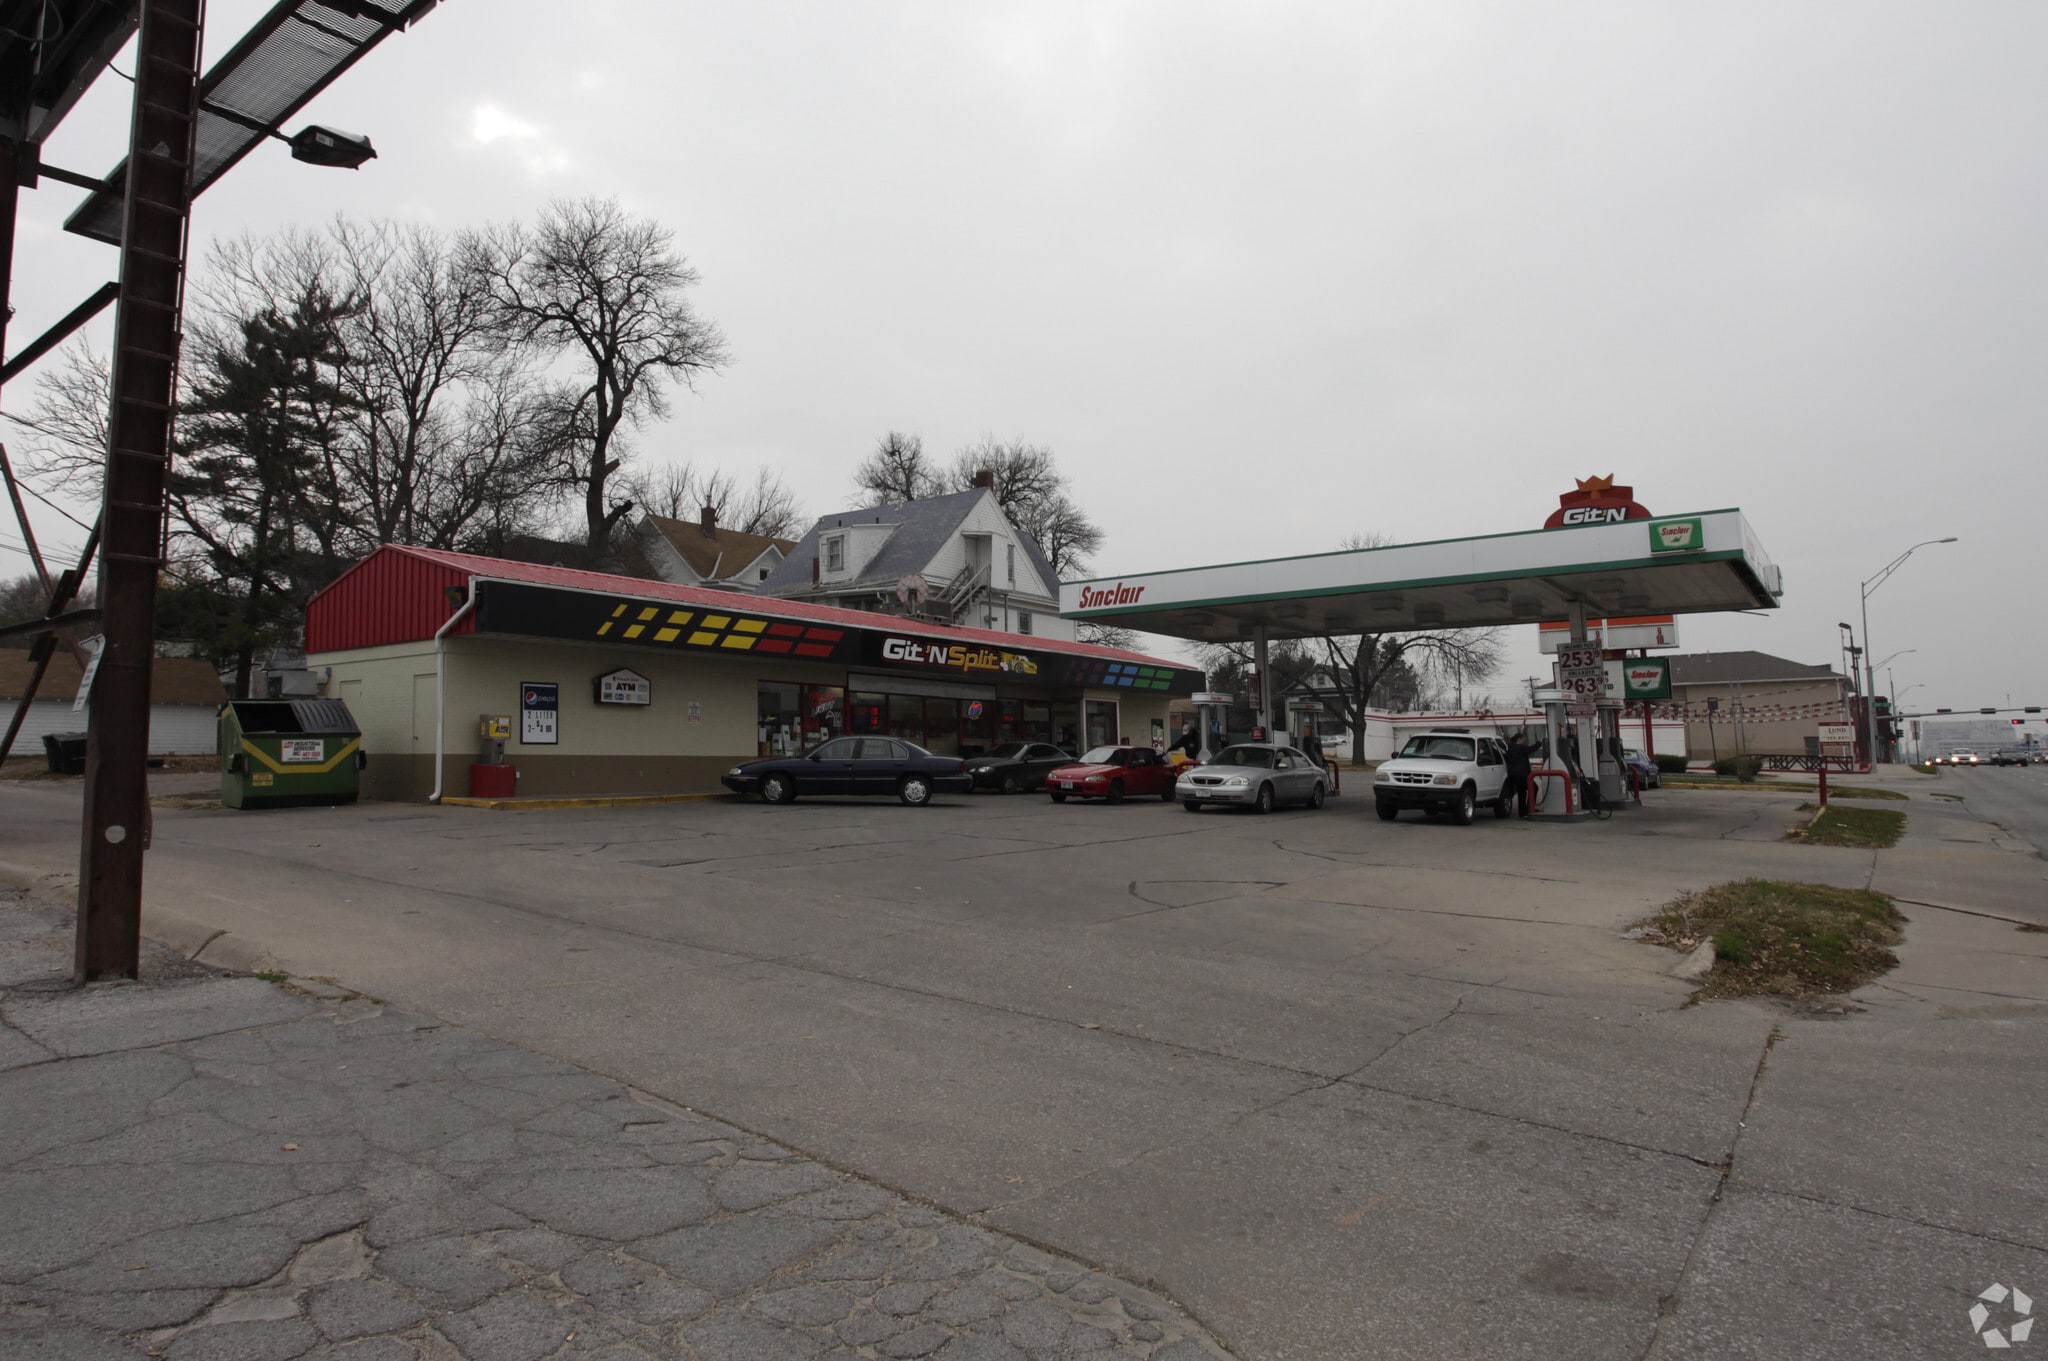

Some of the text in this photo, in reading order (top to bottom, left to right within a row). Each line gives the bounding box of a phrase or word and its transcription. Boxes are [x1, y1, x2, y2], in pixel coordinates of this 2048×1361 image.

[1661, 526, 1690, 536] Sinclair
[1079, 582, 1145, 608] Sinclair
[947, 645, 999, 672] Split
[1631, 670, 1659, 679] Sinclair
[616, 682, 636, 691] ATM
